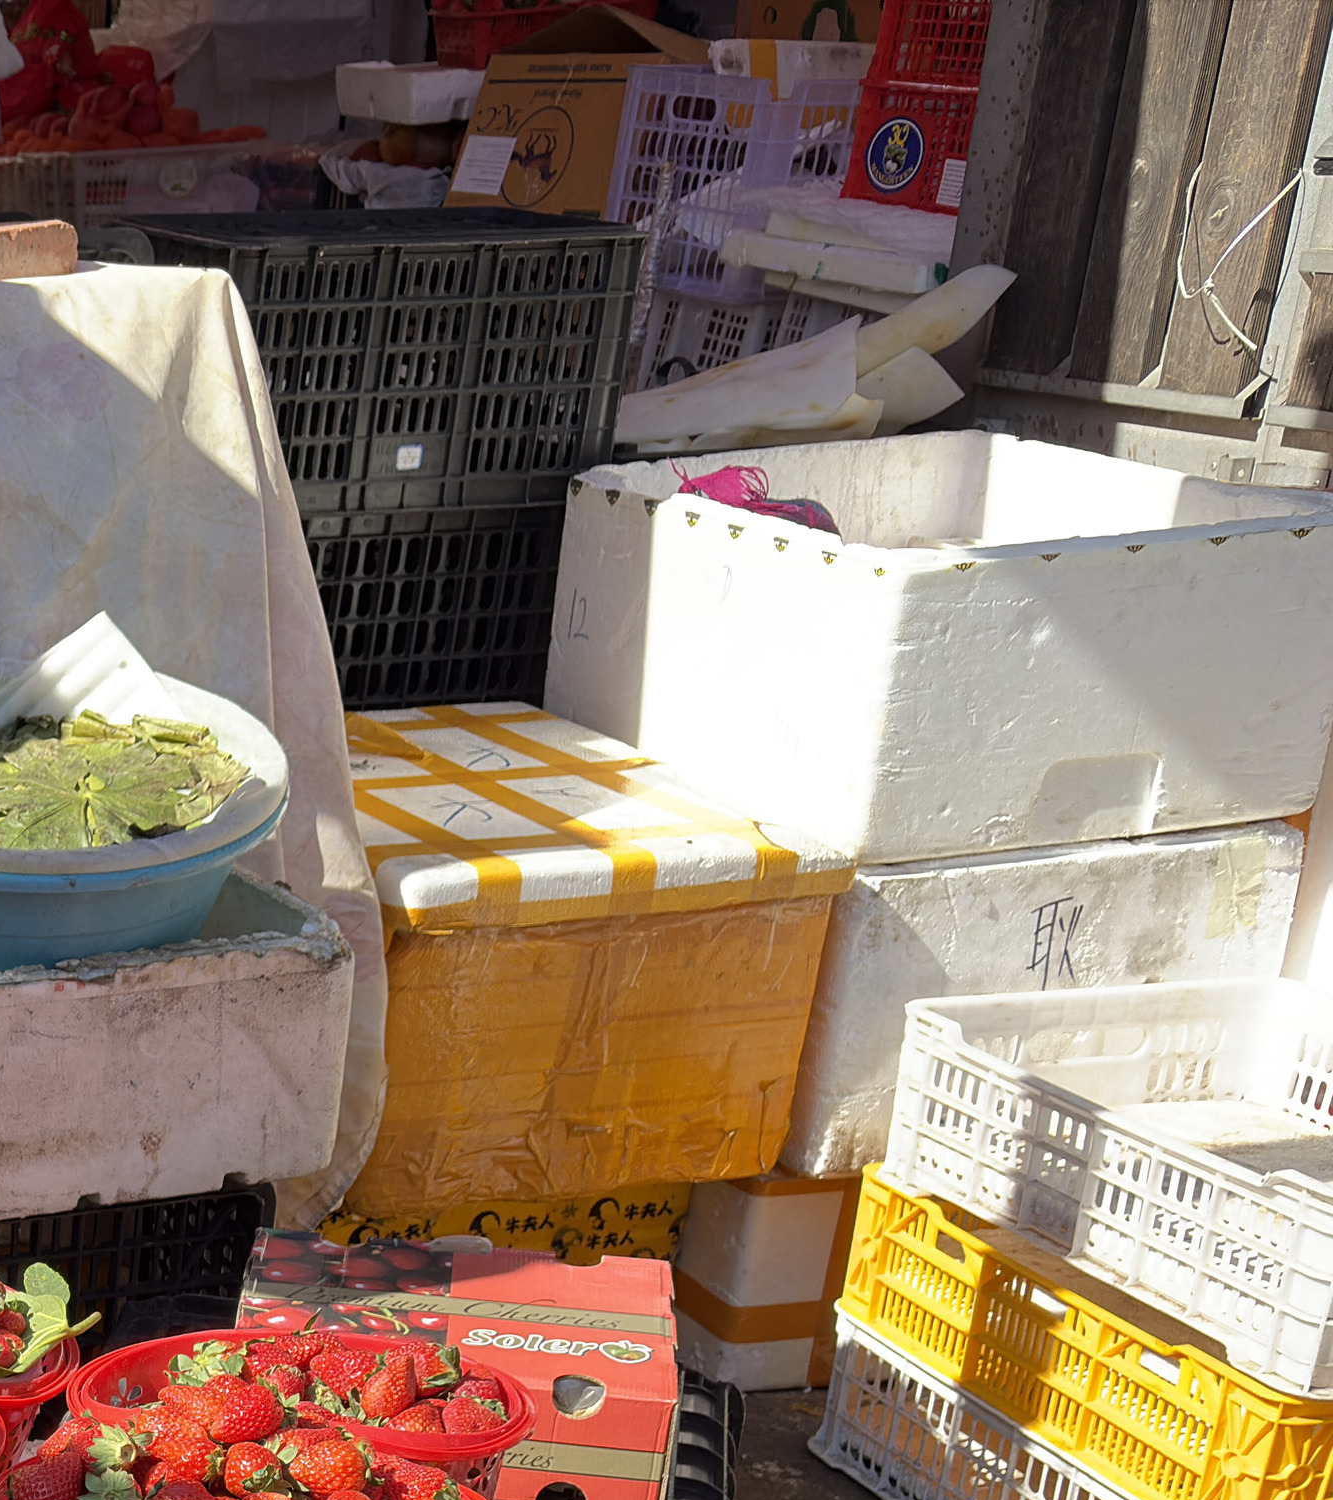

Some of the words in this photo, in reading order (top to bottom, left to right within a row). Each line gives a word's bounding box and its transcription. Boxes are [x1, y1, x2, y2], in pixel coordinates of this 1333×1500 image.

[624, 1199, 674, 1221] 牛夫人
[505, 1214, 555, 1235] 牛夫人
[586, 1228, 635, 1251] 牛夫人
[285, 1282, 447, 1314] Premium
[463, 1298, 622, 1330] Cherries
[461, 1327, 603, 1357] Soler
[504, 1443, 555, 1469] rries
